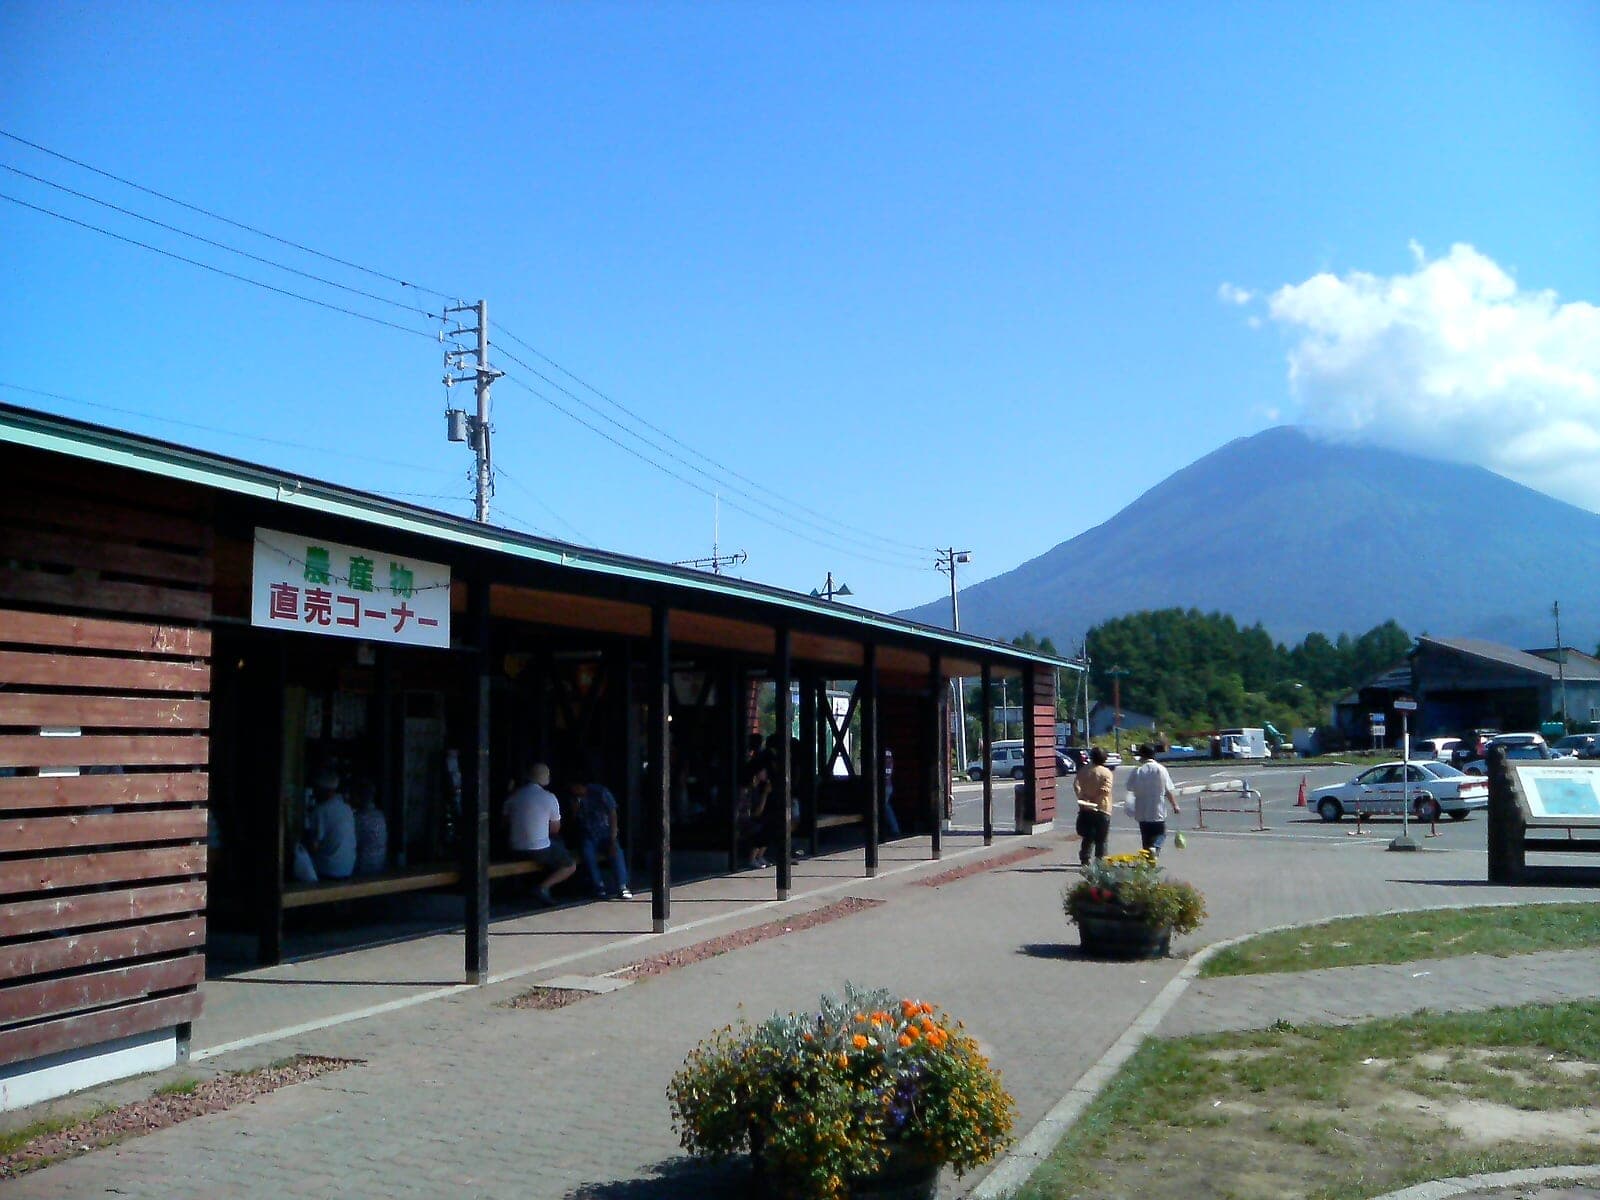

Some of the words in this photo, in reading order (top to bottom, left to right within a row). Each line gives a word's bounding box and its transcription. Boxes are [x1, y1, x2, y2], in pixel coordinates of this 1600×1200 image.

[304, 546, 414, 599] 農産物
[269, 582, 439, 633] 直売コーナー
